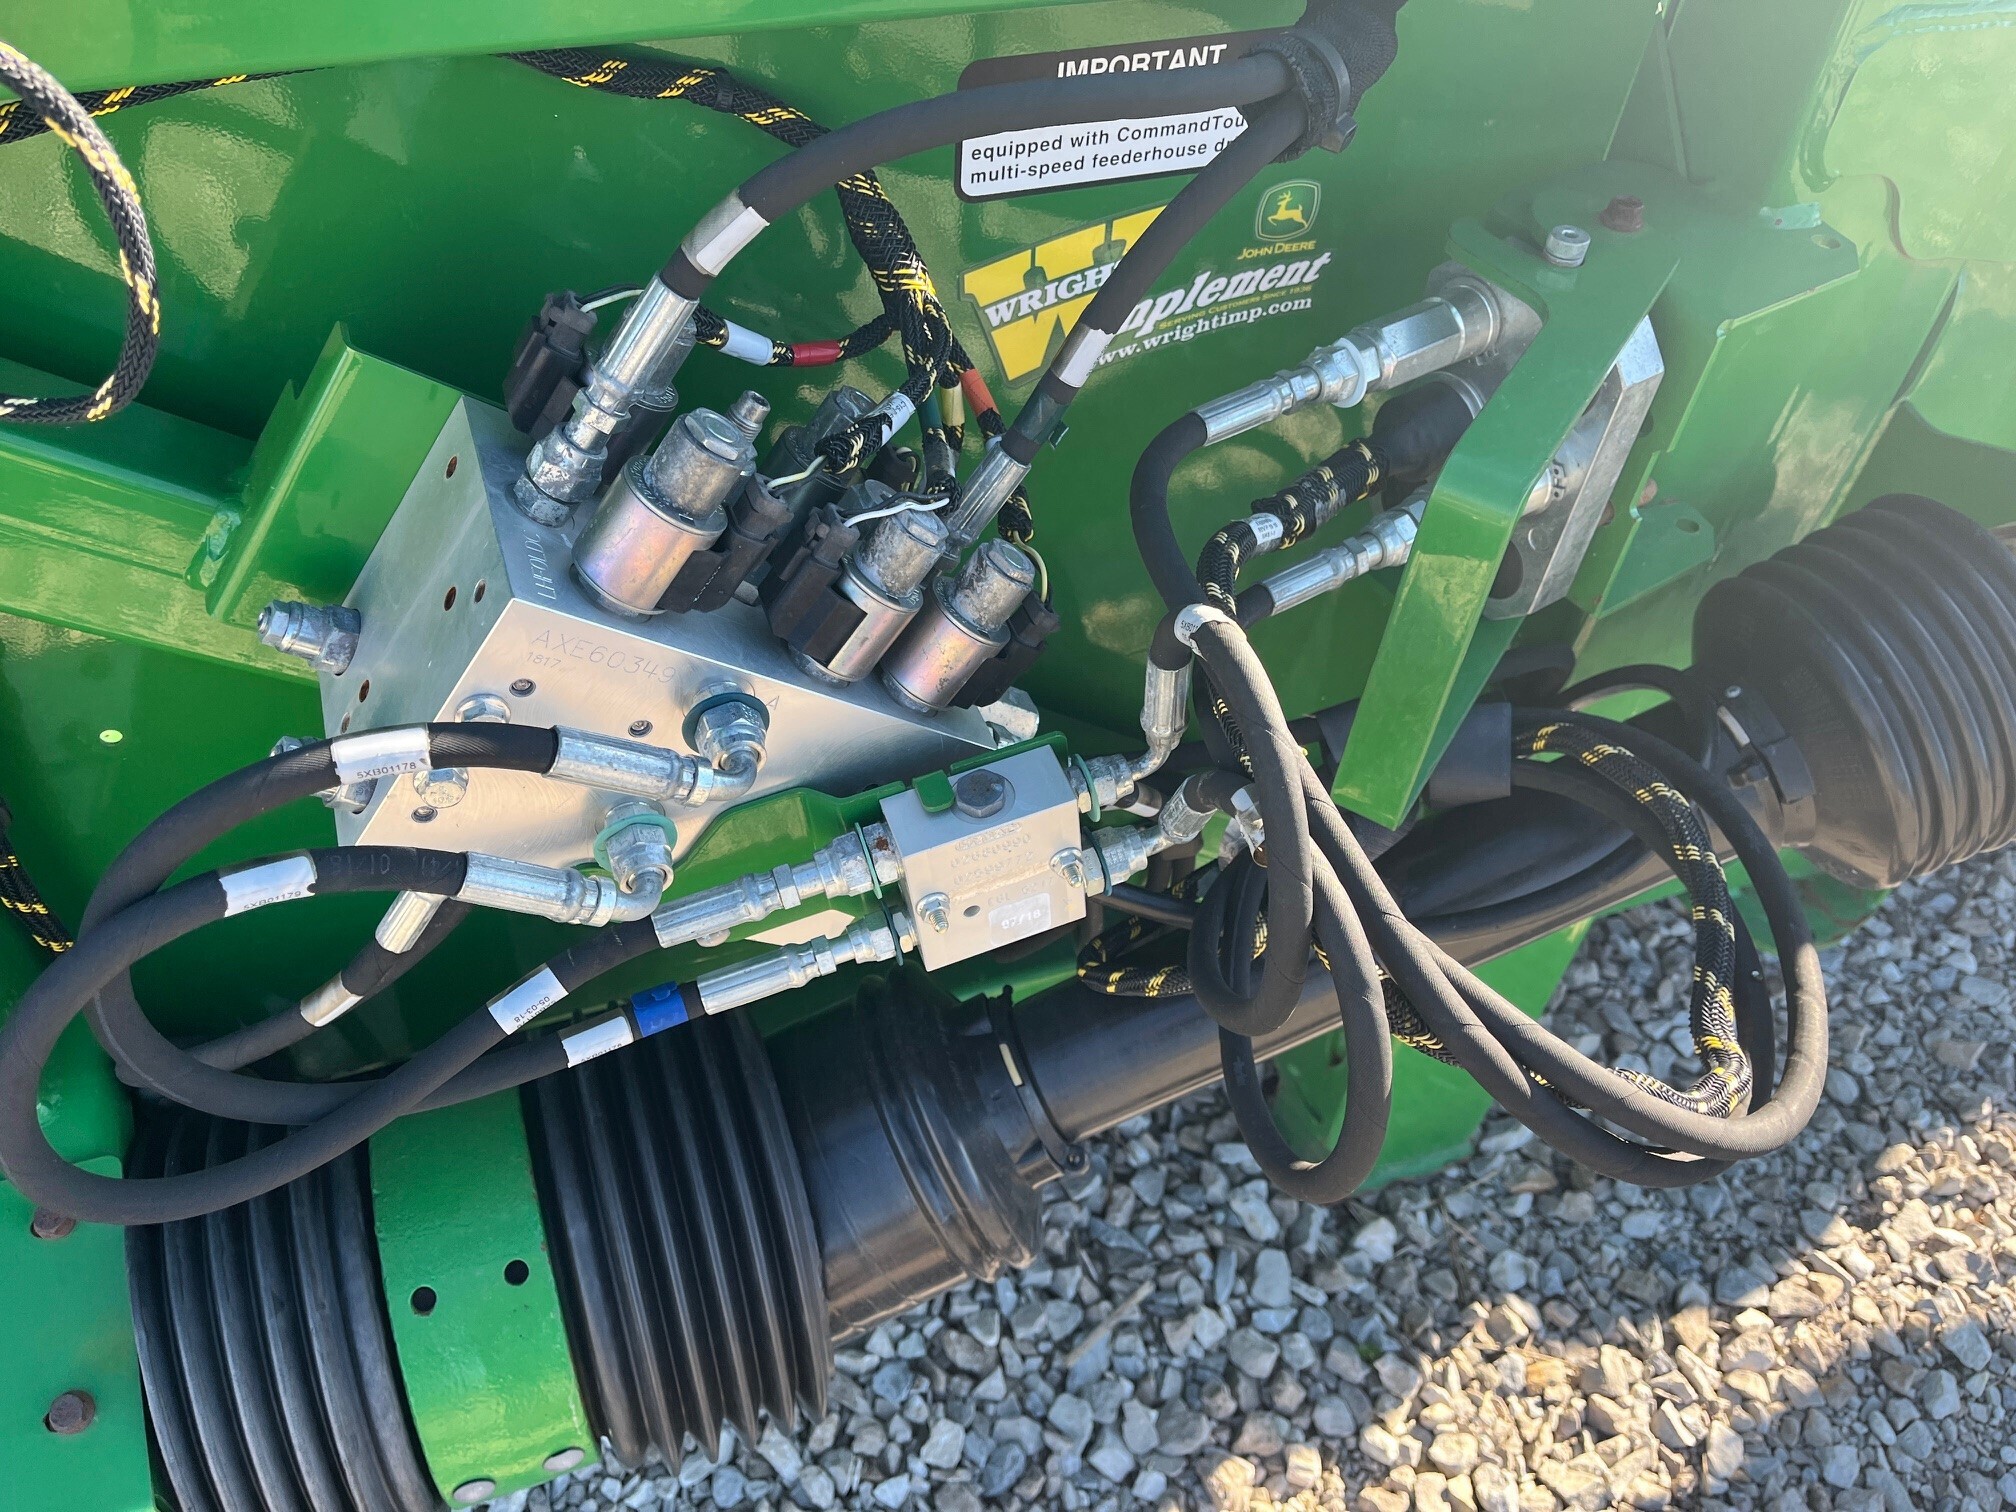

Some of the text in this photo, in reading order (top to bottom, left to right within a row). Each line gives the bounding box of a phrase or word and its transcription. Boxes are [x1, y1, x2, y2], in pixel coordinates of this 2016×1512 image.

[1057, 43, 1228, 78] IMPORTANT
[971, 115, 1245, 161] equipped with CommandTou
[971, 155, 1085, 184] multi-speed
[1092, 142, 1207, 169] feederhouse
[1237, 240, 1317, 260] JOHN DEERE
[985, 260, 1121, 328] WRIGH
[1117, 252, 1332, 339] mplement
[1098, 298, 1313, 366] ww.wrightimp.com
[526, 651, 563, 669] 1817
[531, 629, 677, 684] AXE60349
[357, 761, 417, 779] 5XB01178
[514, 996, 551, 1023] 05-03-18
